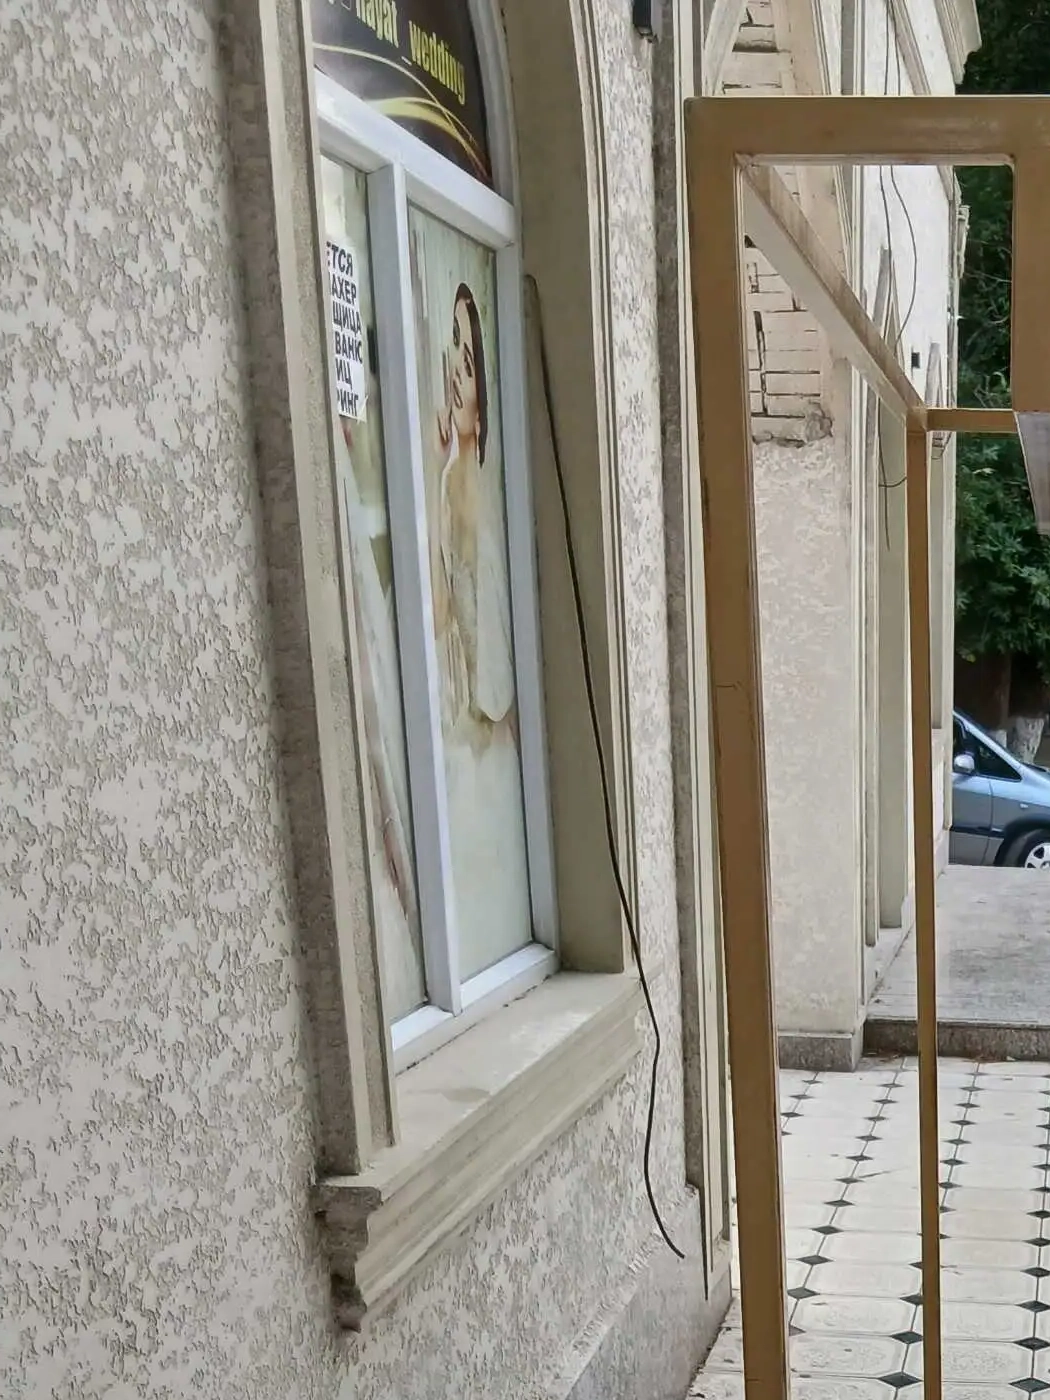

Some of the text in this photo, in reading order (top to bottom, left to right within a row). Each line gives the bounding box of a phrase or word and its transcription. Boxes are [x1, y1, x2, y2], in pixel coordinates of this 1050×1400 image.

[408, 20, 465, 105] wedding
[327, 241, 353, 277] ТСЯ
[329, 272, 356, 306] АХЕР
